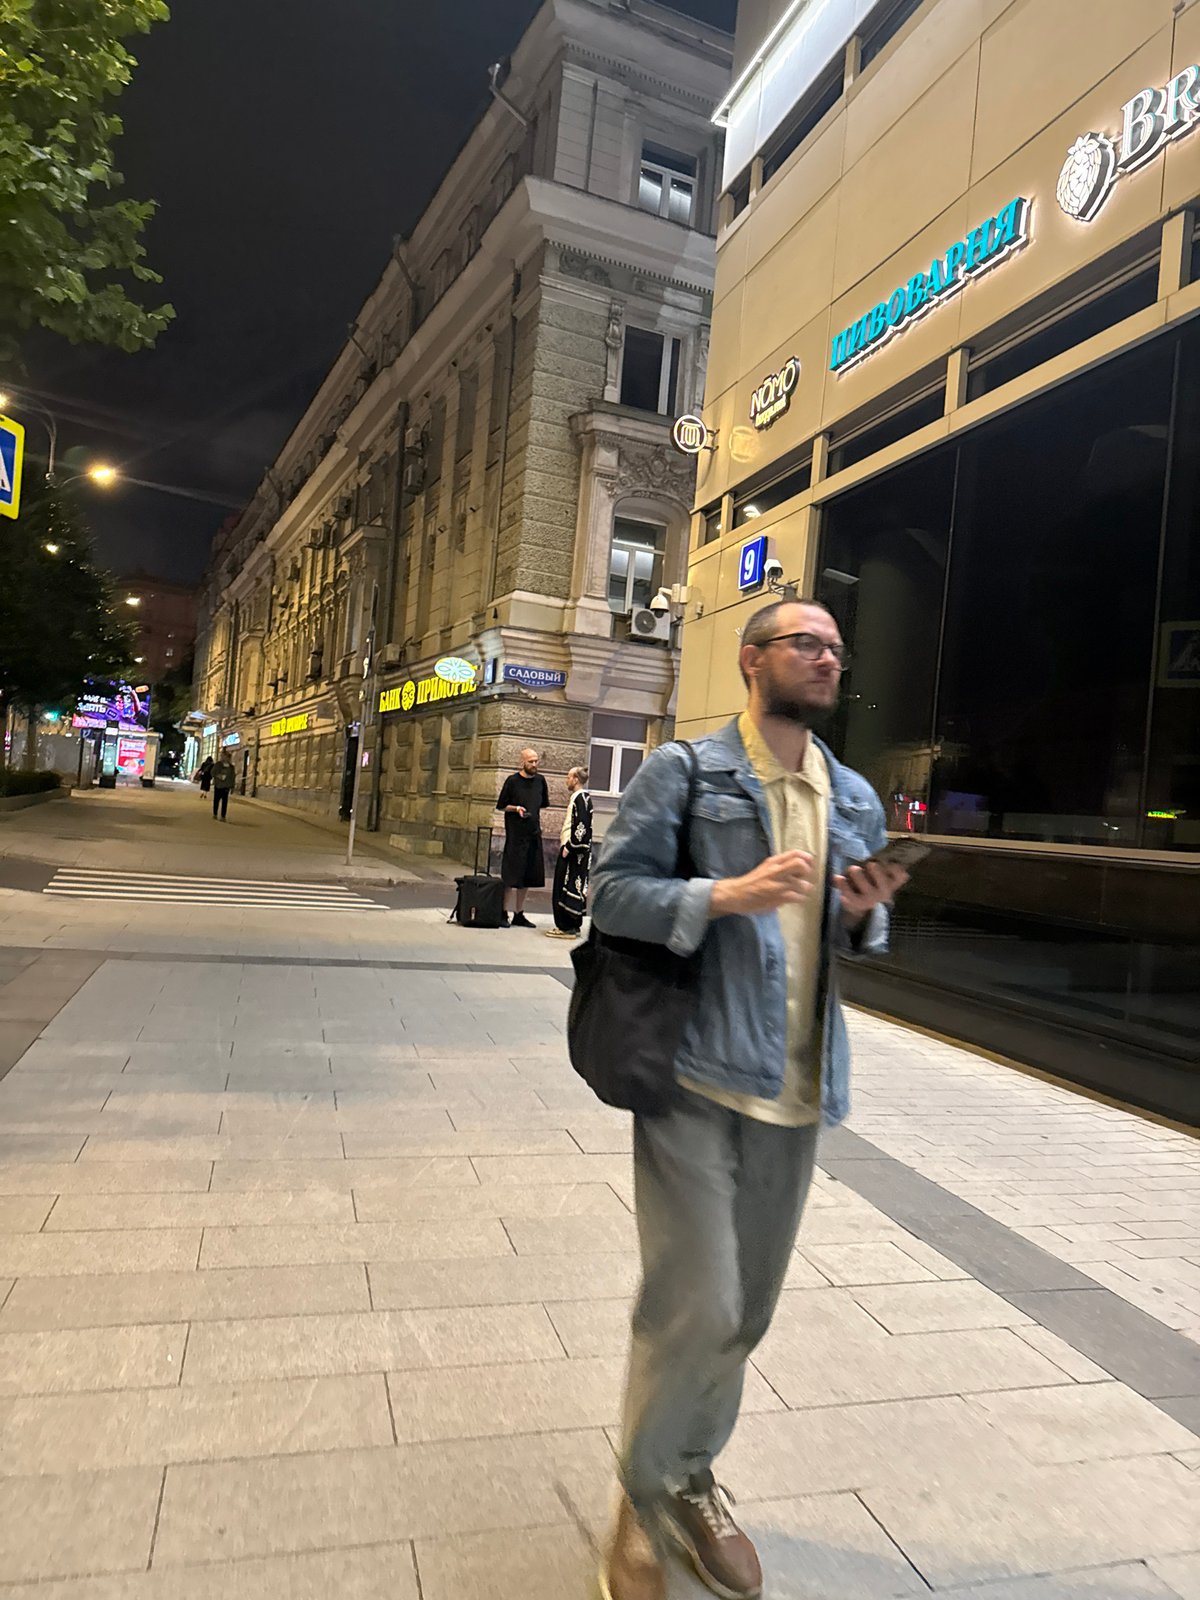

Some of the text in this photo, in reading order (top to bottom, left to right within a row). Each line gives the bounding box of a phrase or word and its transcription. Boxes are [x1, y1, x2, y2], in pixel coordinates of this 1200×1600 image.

[829, 196, 1024, 371] ПИВОВАРНЯ
[743, 549, 756, 581] 9
[508, 668, 562, 683] САДОВЫЙ
[378, 687, 402, 712] БАНК
